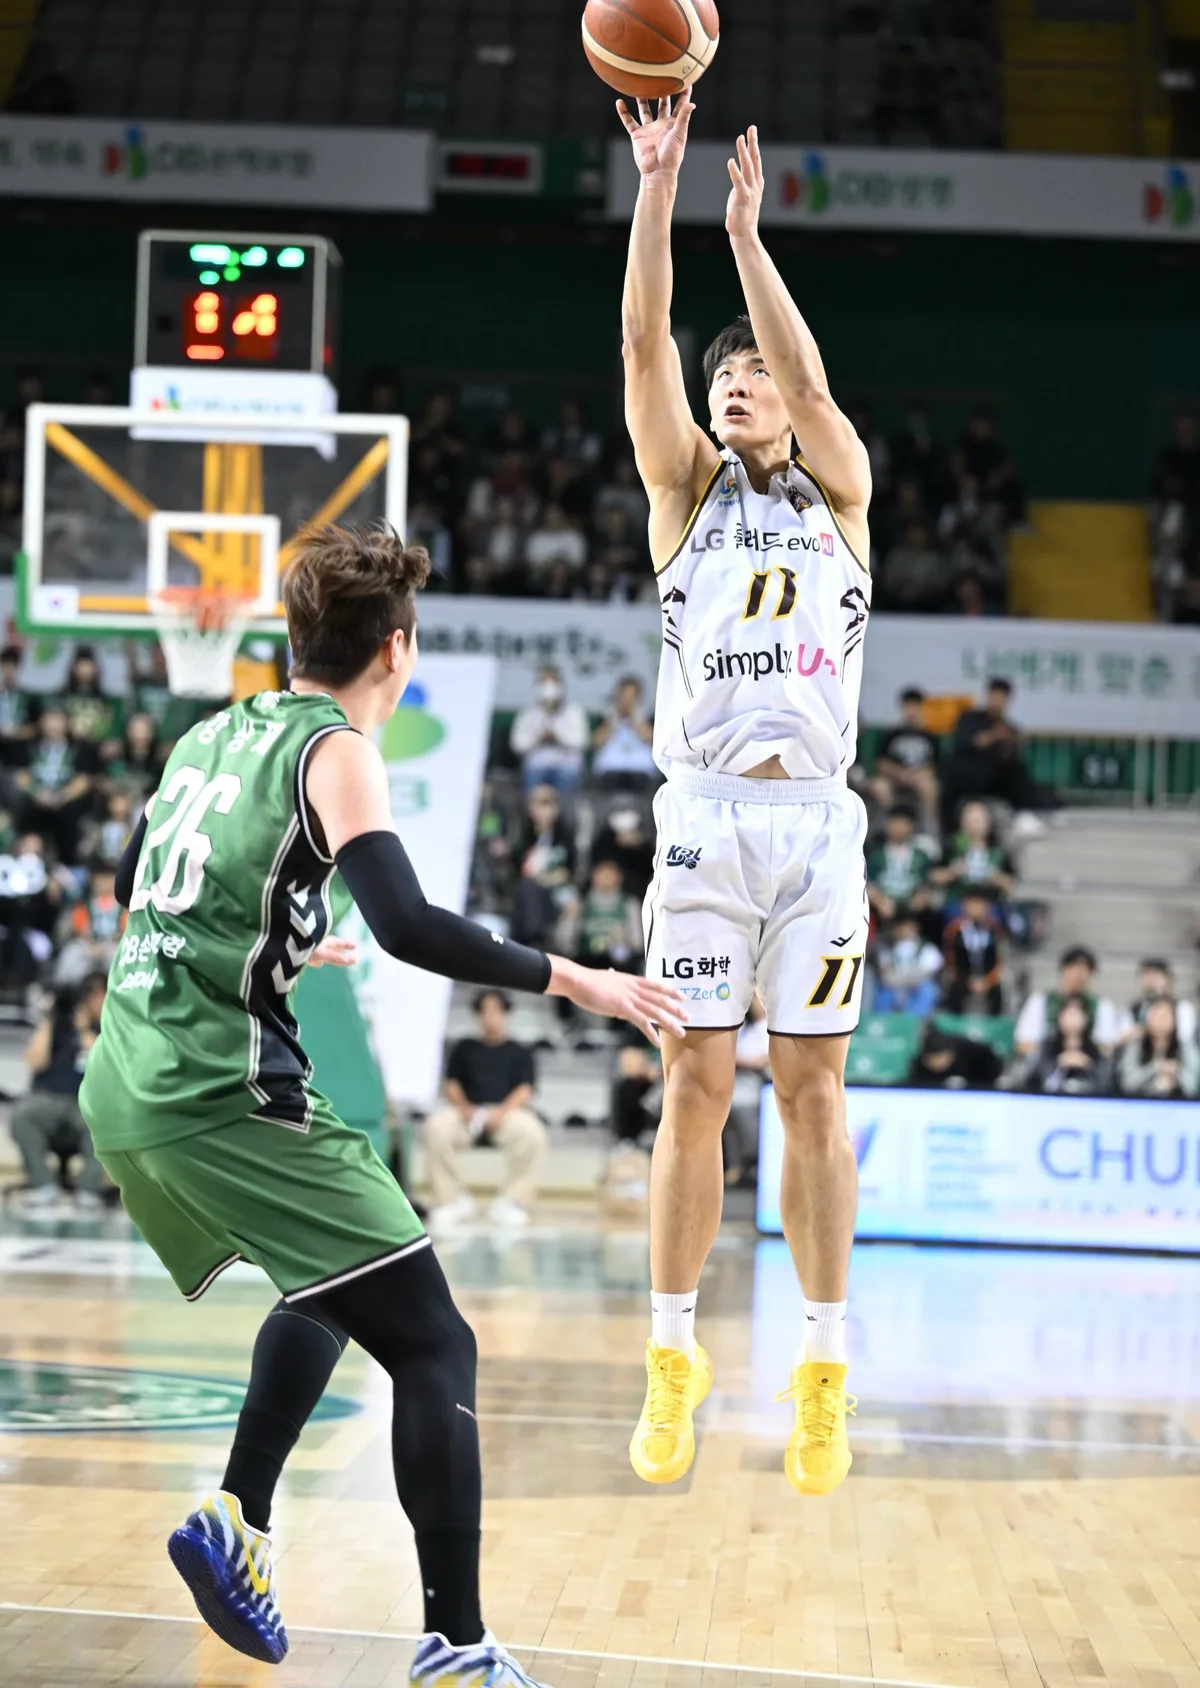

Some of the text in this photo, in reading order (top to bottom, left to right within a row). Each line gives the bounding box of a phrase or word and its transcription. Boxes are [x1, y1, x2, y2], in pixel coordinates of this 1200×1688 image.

[690, 528, 725, 554] LG
[787, 537, 820, 552] evo
[741, 565, 799, 623] 11
[129, 764, 242, 916] 26
[662, 956, 731, 979] LG 화학
[804, 953, 864, 1010] 11
[1038, 1127, 1200, 1187] CHU
